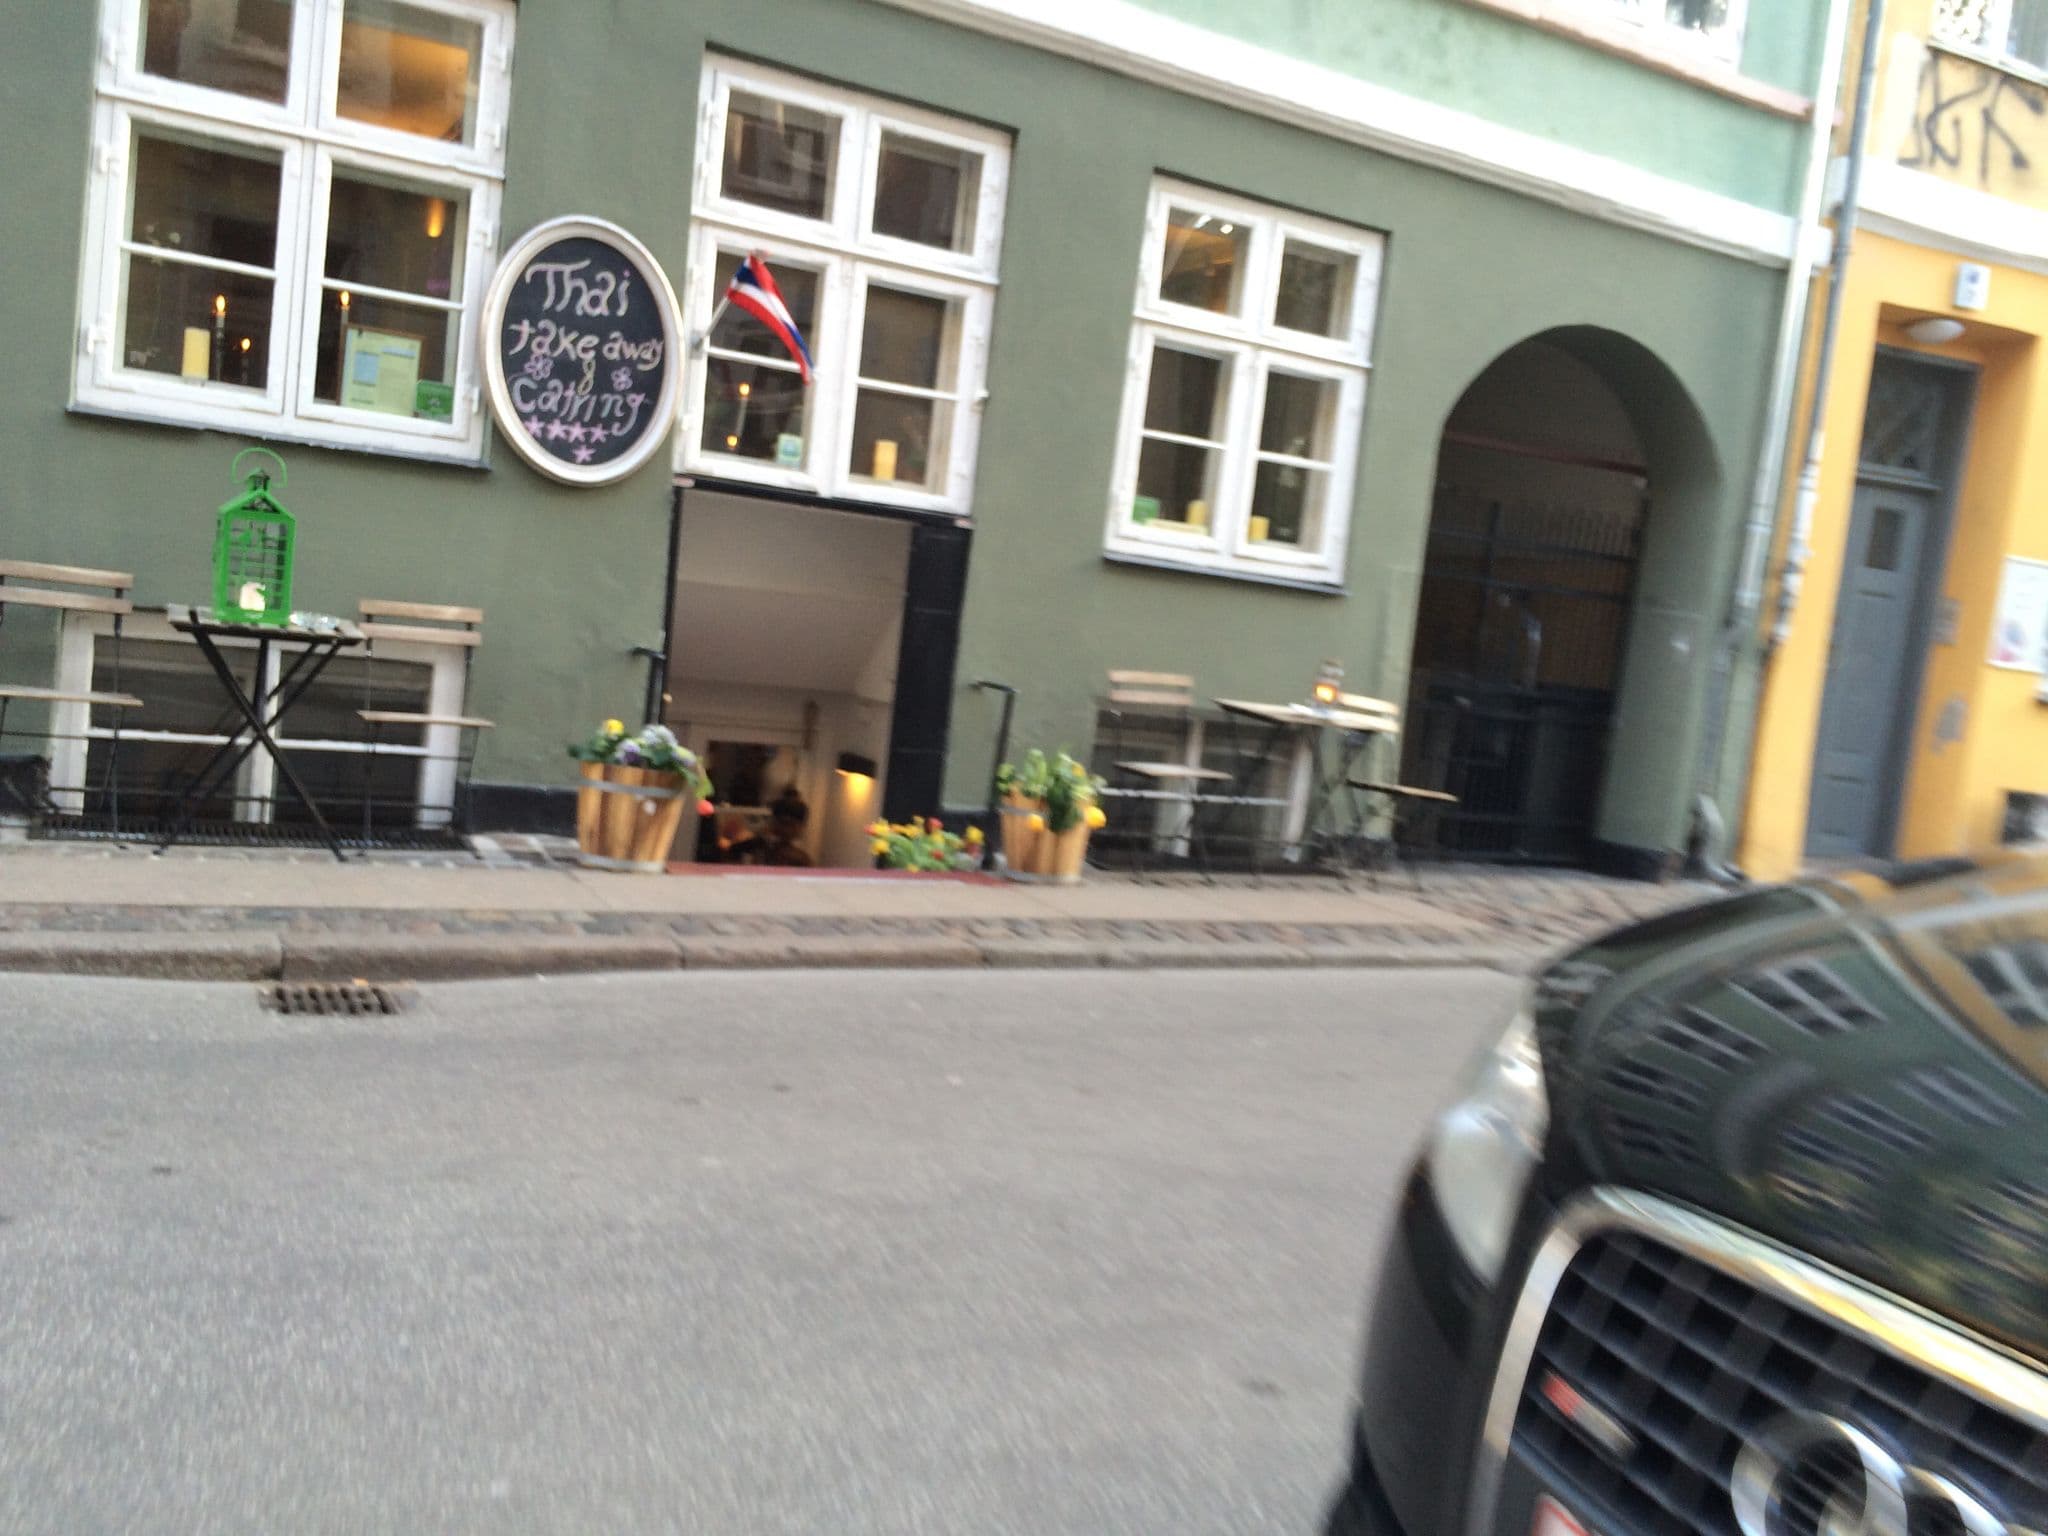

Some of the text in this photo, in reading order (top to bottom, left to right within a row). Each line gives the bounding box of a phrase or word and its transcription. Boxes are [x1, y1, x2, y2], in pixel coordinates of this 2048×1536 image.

[525, 259, 630, 317] Thai
[508, 319, 664, 371] take away
